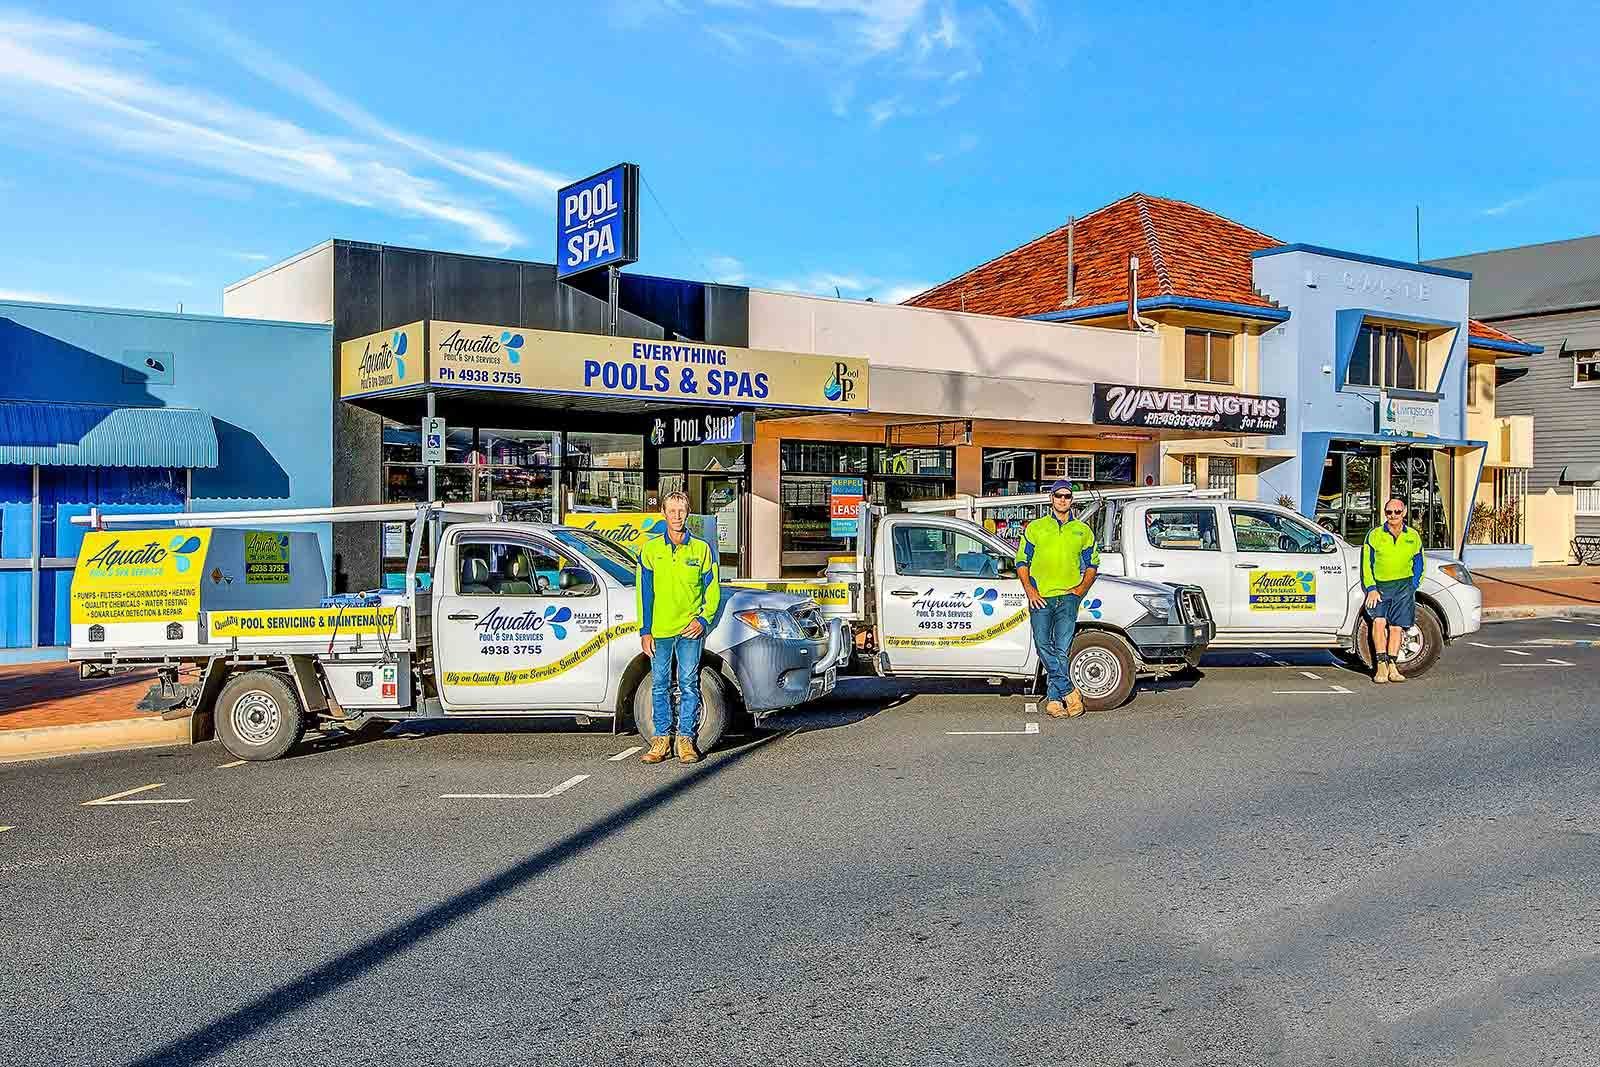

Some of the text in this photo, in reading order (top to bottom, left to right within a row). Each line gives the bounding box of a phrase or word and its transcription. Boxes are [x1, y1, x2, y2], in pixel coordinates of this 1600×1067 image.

[565, 179, 618, 227] POOL
[587, 219, 595, 229] &
[567, 224, 615, 267] SPA
[439, 329, 501, 357] Aquatic
[358, 341, 393, 379] Aquatic
[444, 353, 459, 362] POOL
[464, 354, 475, 363] SPA
[475, 355, 501, 365] SERVICES
[633, 343, 728, 366] EVERYTHING
[439, 368, 522, 385] Ph 4938 3755
[584, 359, 769, 399] POOLS & SPAS
[835, 362, 859, 386] Pool
[1106, 387, 1280, 421] WAVELENGTHS
[430, 421, 438, 433] P
[673, 414, 735, 443] POOL SHOP
[1240, 416, 1278, 429] for hair
[832, 479, 862, 487] KEPPEL
[85, 539, 168, 571] Aquatic
[1253, 573, 1297, 590] Aquatic
[78, 588, 195, 600] PUMPS FILTERS CHLORINATORS HEATING
[84, 598, 188, 609] QUALITY CHEMICALS WATER TESTING
[90, 609, 111, 618] SONAR
[125, 608, 157, 617] DETECTION
[162, 608, 183, 616] REPAIR
[474, 606, 545, 636] Aquatic
[916, 610, 930, 618] POOL
[936, 610, 946, 618] SPA
[948, 610, 973, 618] SERVICES
[214, 614, 394, 631] Quality POOL SERVICING & MAINTENANCE
[918, 621, 972, 630] 4938 3755
[986, 622, 1005, 638] Small
[1004, 609, 1028, 631] enough
[480, 633, 544, 642] POOL & SPA SERVICES
[446, 672, 459, 685] Big
[472, 672, 502, 685] Quality.
[504, 671, 517, 683] Big
[530, 667, 560, 679] Service.
[560, 651, 581, 670] Small
[580, 635, 605, 657] enough
[604, 631, 614, 640] to
[615, 625, 638, 636] Care.
[481, 645, 542, 655] 4938 3755
